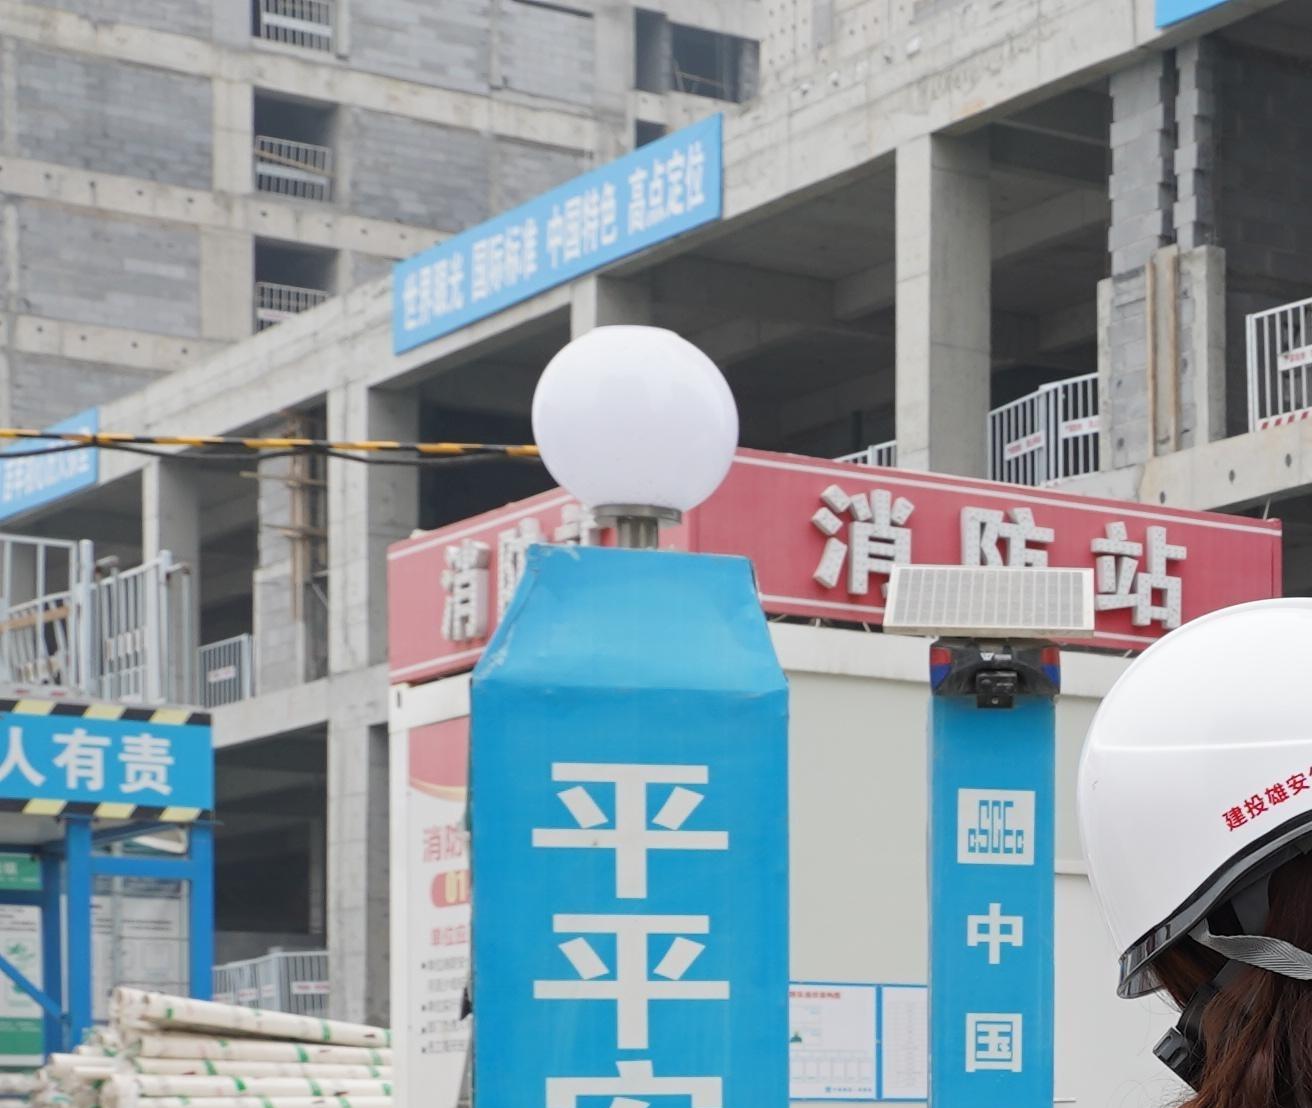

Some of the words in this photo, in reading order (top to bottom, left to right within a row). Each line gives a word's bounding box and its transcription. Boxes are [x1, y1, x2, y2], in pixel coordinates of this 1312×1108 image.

[546, 182, 617, 268] 中国特色
[627, 141, 706, 235] 高点定位
[0, 726, 174, 795] 人有责
